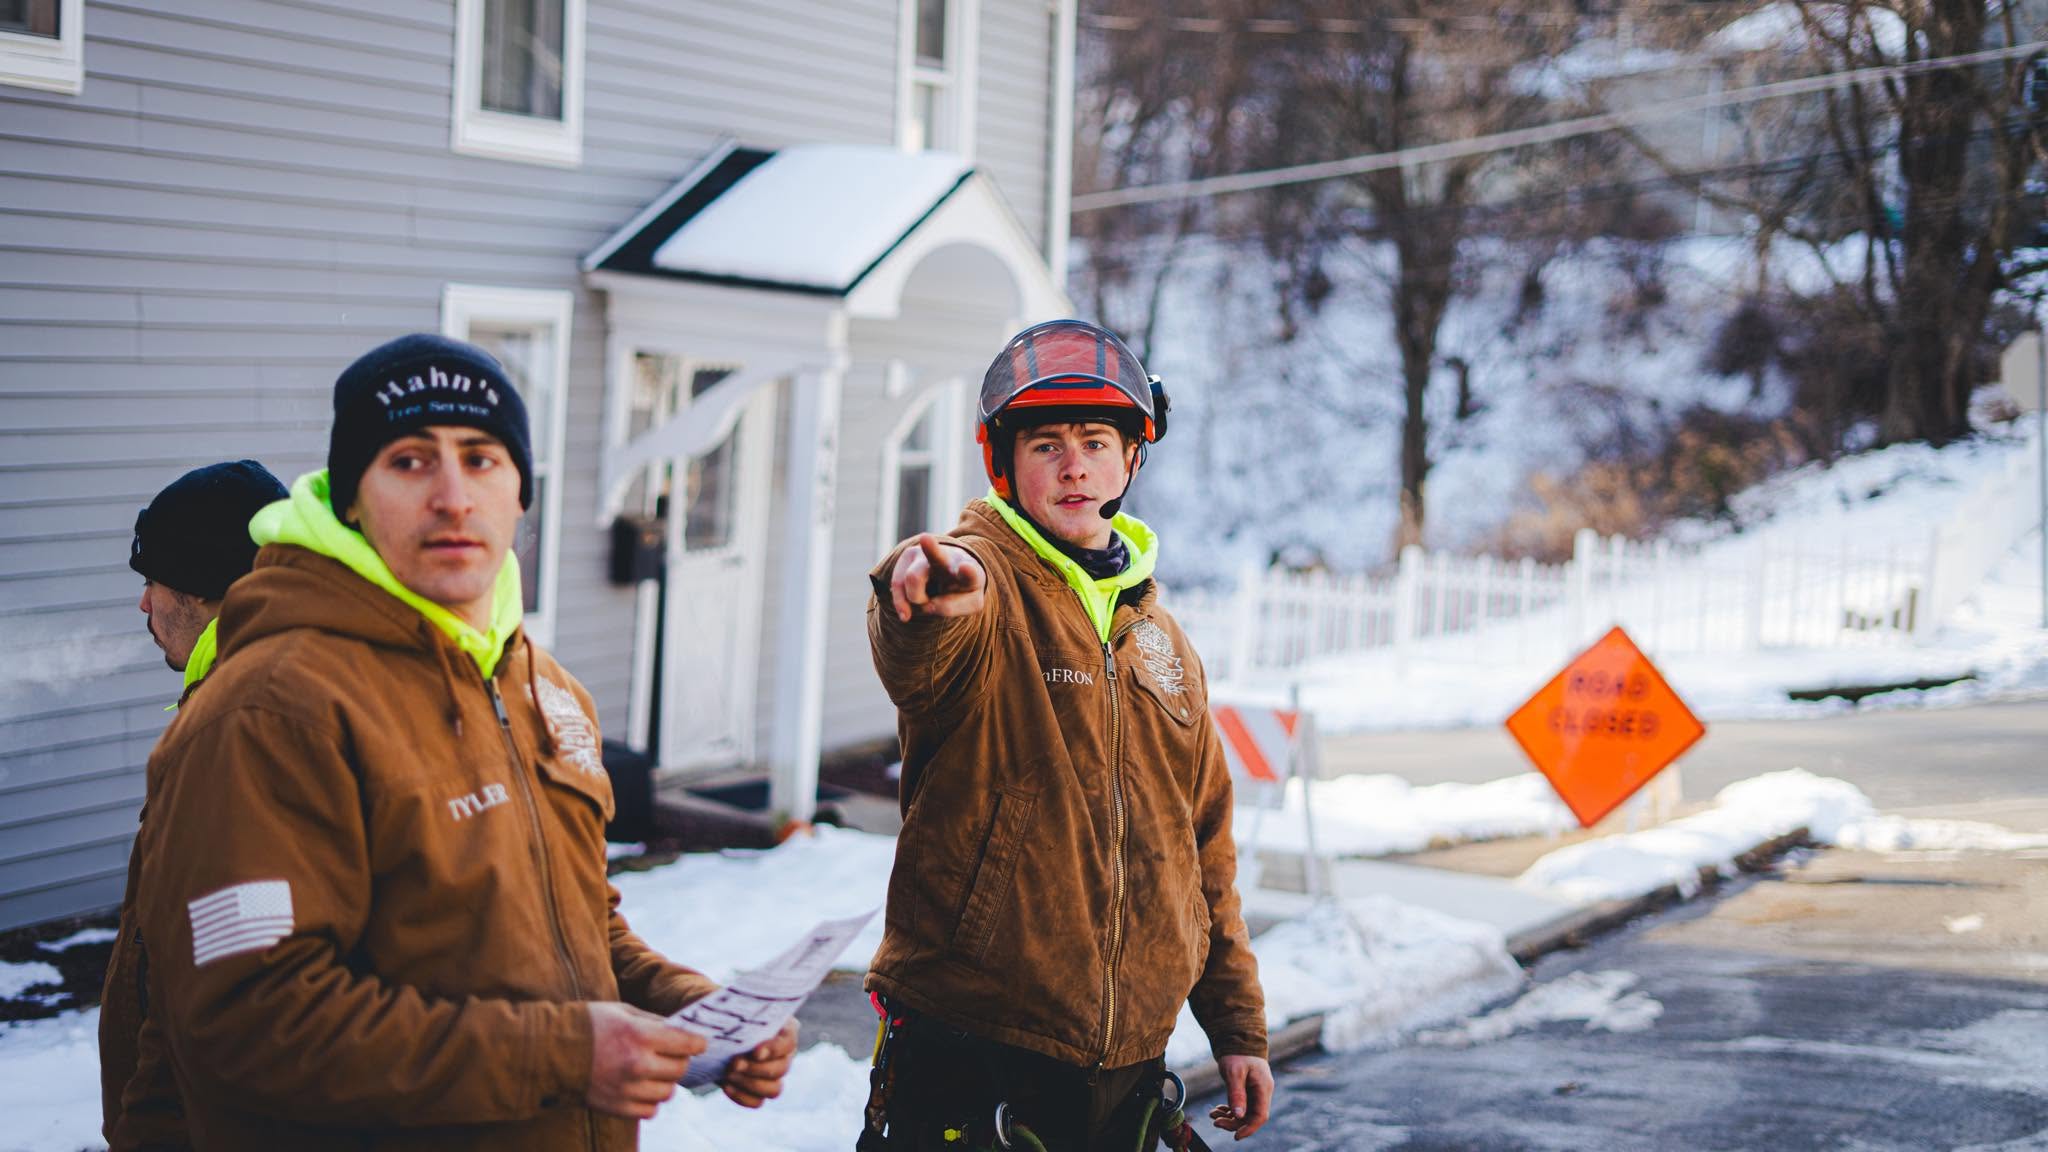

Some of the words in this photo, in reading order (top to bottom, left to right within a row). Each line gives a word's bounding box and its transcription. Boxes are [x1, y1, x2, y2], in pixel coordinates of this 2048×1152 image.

[376, 365, 499, 406] Hahn's
[427, 400, 491, 416] Service
[1567, 669, 1650, 702] ROAD
[1547, 704, 1661, 739] CLOSED
[448, 784, 510, 821] TYLER
